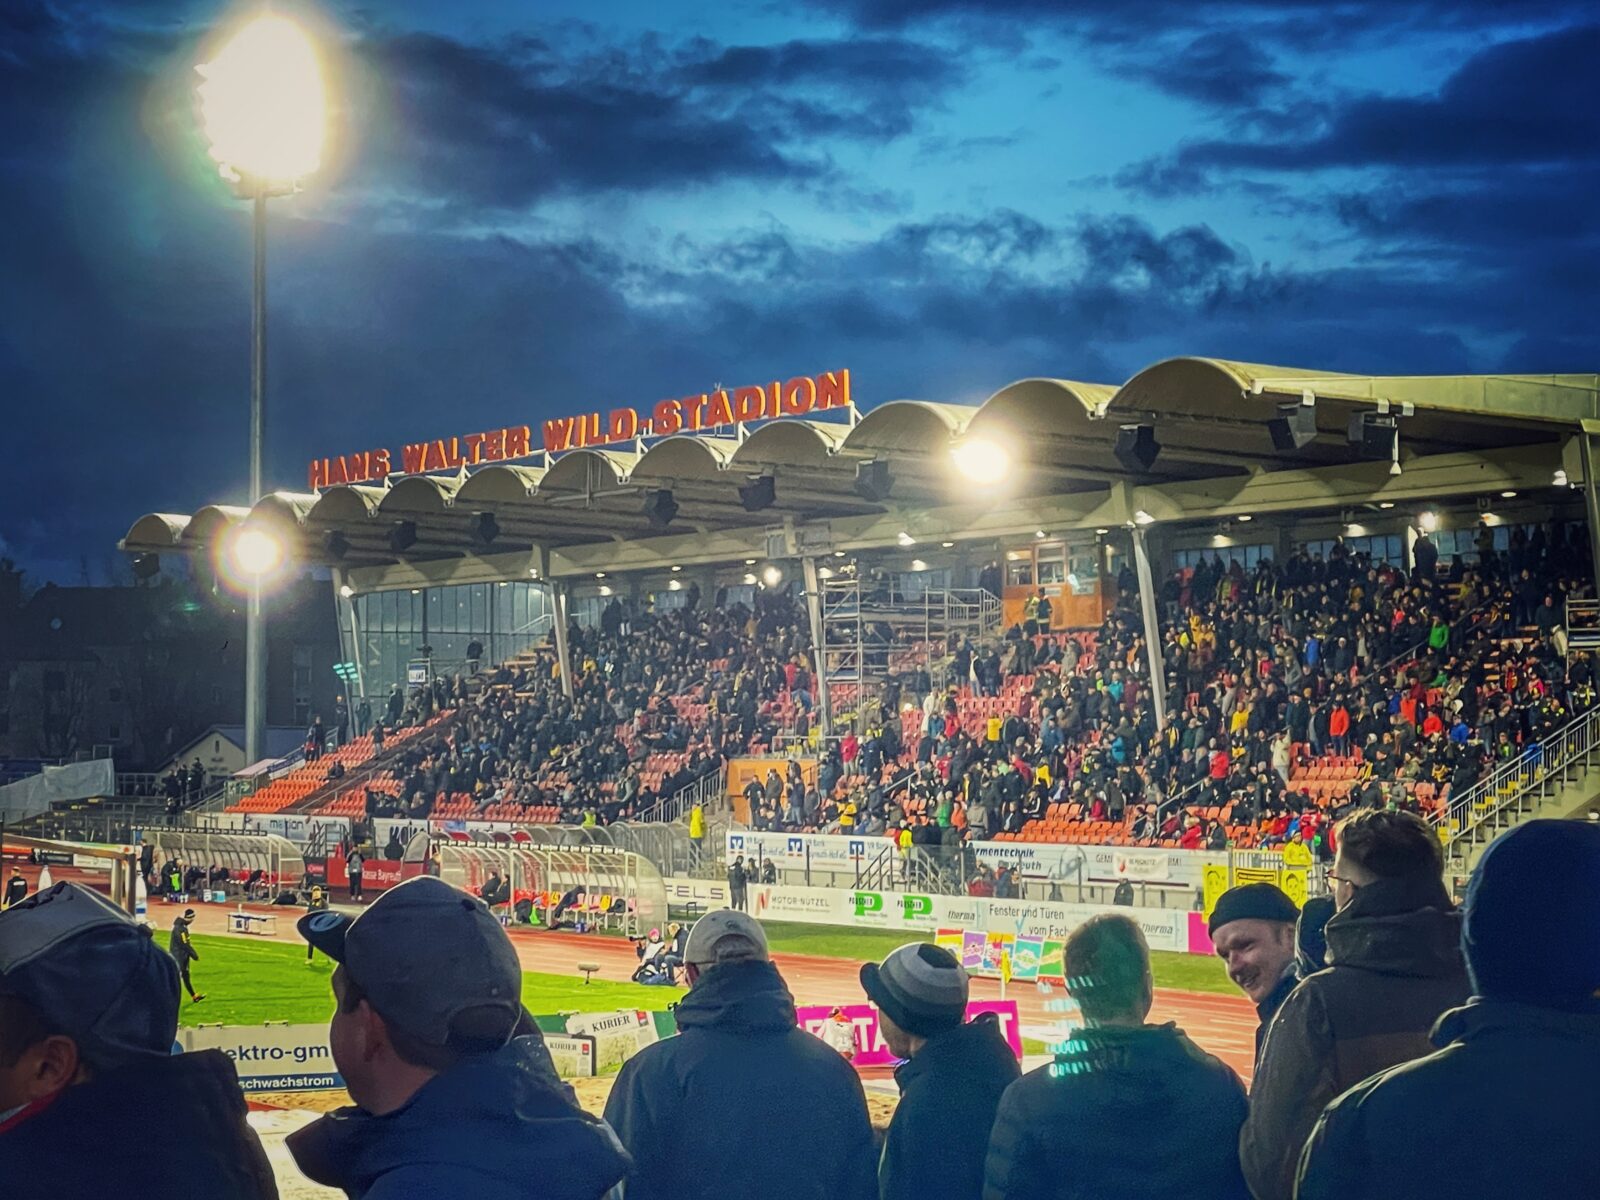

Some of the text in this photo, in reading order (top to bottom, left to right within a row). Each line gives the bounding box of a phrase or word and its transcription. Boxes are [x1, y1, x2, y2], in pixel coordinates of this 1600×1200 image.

[308, 449, 391, 488] HANS
[402, 426, 531, 474] WALTER
[975, 847, 1035, 858] rmentechnik
[989, 904, 1064, 919] Fenster und Türen
[1029, 926, 1047, 936] vom
[592, 1014, 631, 1032] KURIER
[550, 1042, 577, 1051] KURIER
